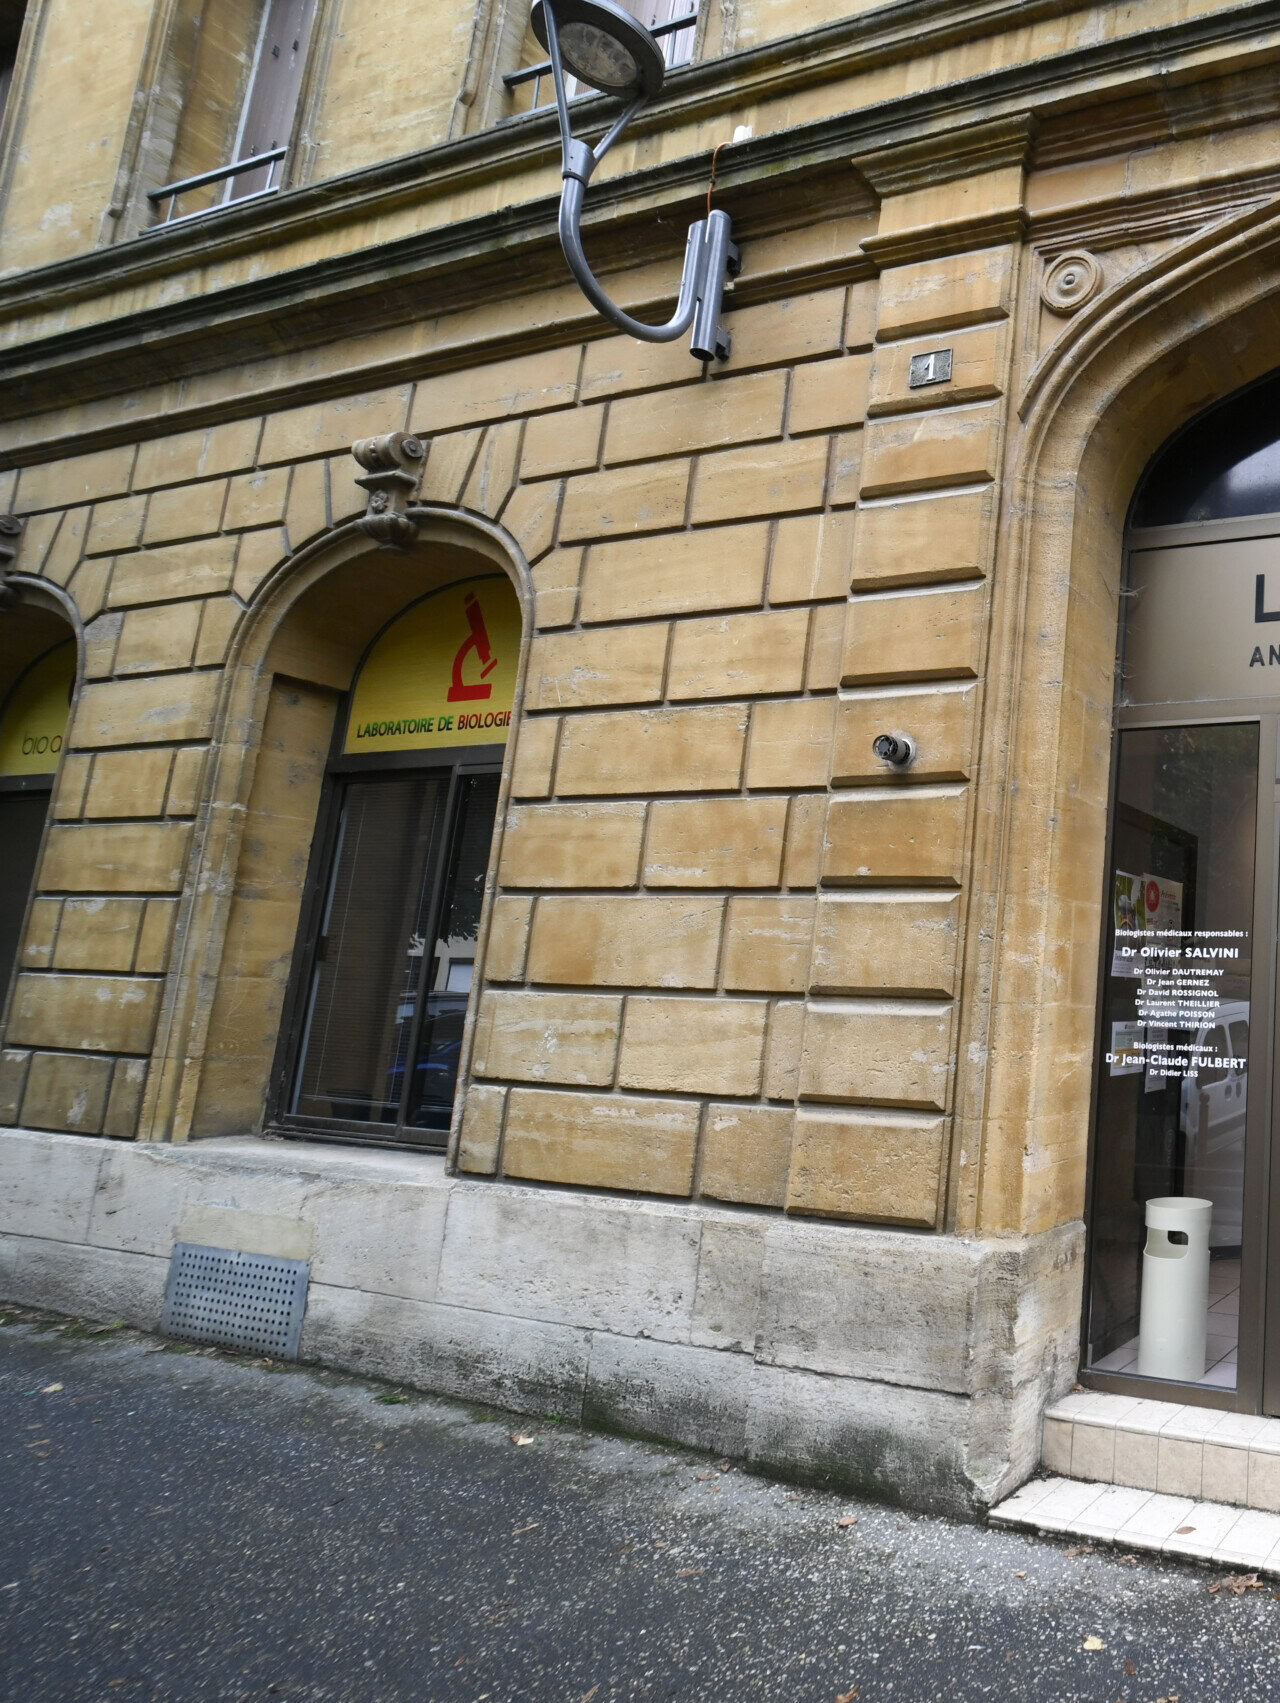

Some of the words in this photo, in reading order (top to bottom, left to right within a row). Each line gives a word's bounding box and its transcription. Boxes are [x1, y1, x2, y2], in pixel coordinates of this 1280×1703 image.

[924, 354, 936, 381] 1
[356, 717, 434, 739] LABORATOIRE
[437, 715, 454, 732] DE
[457, 710, 512, 730] BIOLOGIE
[1115, 929, 1154, 938] Biologistes
[1156, 928, 1192, 937] médicaux
[1194, 930, 1244, 938] responsables
[1121, 946, 1137, 957] Dr
[1140, 946, 1181, 958] Olivier
[1185, 947, 1239, 958] SALVINI
[1133, 967, 1144, 975] Dr
[1145, 967, 1170, 976] Olivier
[1172, 968, 1225, 976] DAUTREMAY
[1146, 978, 1157, 986] Dr
[1157, 979, 1175, 987] Jean
[1176, 979, 1210, 987] GERNEZ
[1136, 988, 1147, 996] Dr
[1148, 988, 1170, 996] David
[1171, 989, 1219, 997] ROSSIGNOL
[1134, 998, 1145, 1006] Dr
[1146, 999, 1176, 1007] Laurent
[1149, 1010, 1177, 1019] Agathe
[1179, 1010, 1216, 1018] POISSON
[1137, 1019, 1147, 1027] Dr
[1148, 1020, 1178, 1028] Vincent
[1179, 1020, 1216, 1029] THIRION
[1133, 1041, 1175, 1052] Biologistes
[1175, 1043, 1213, 1052] médicaux
[1105, 1053, 1119, 1063] Dr
[1121, 1053, 1188, 1067] Jean-Claude
[1191, 1056, 1247, 1068] FULBERT
[1149, 1068, 1159, 1076] Dr
[1160, 1069, 1182, 1077] Didier
[1183, 1070, 1199, 1078] LISS
